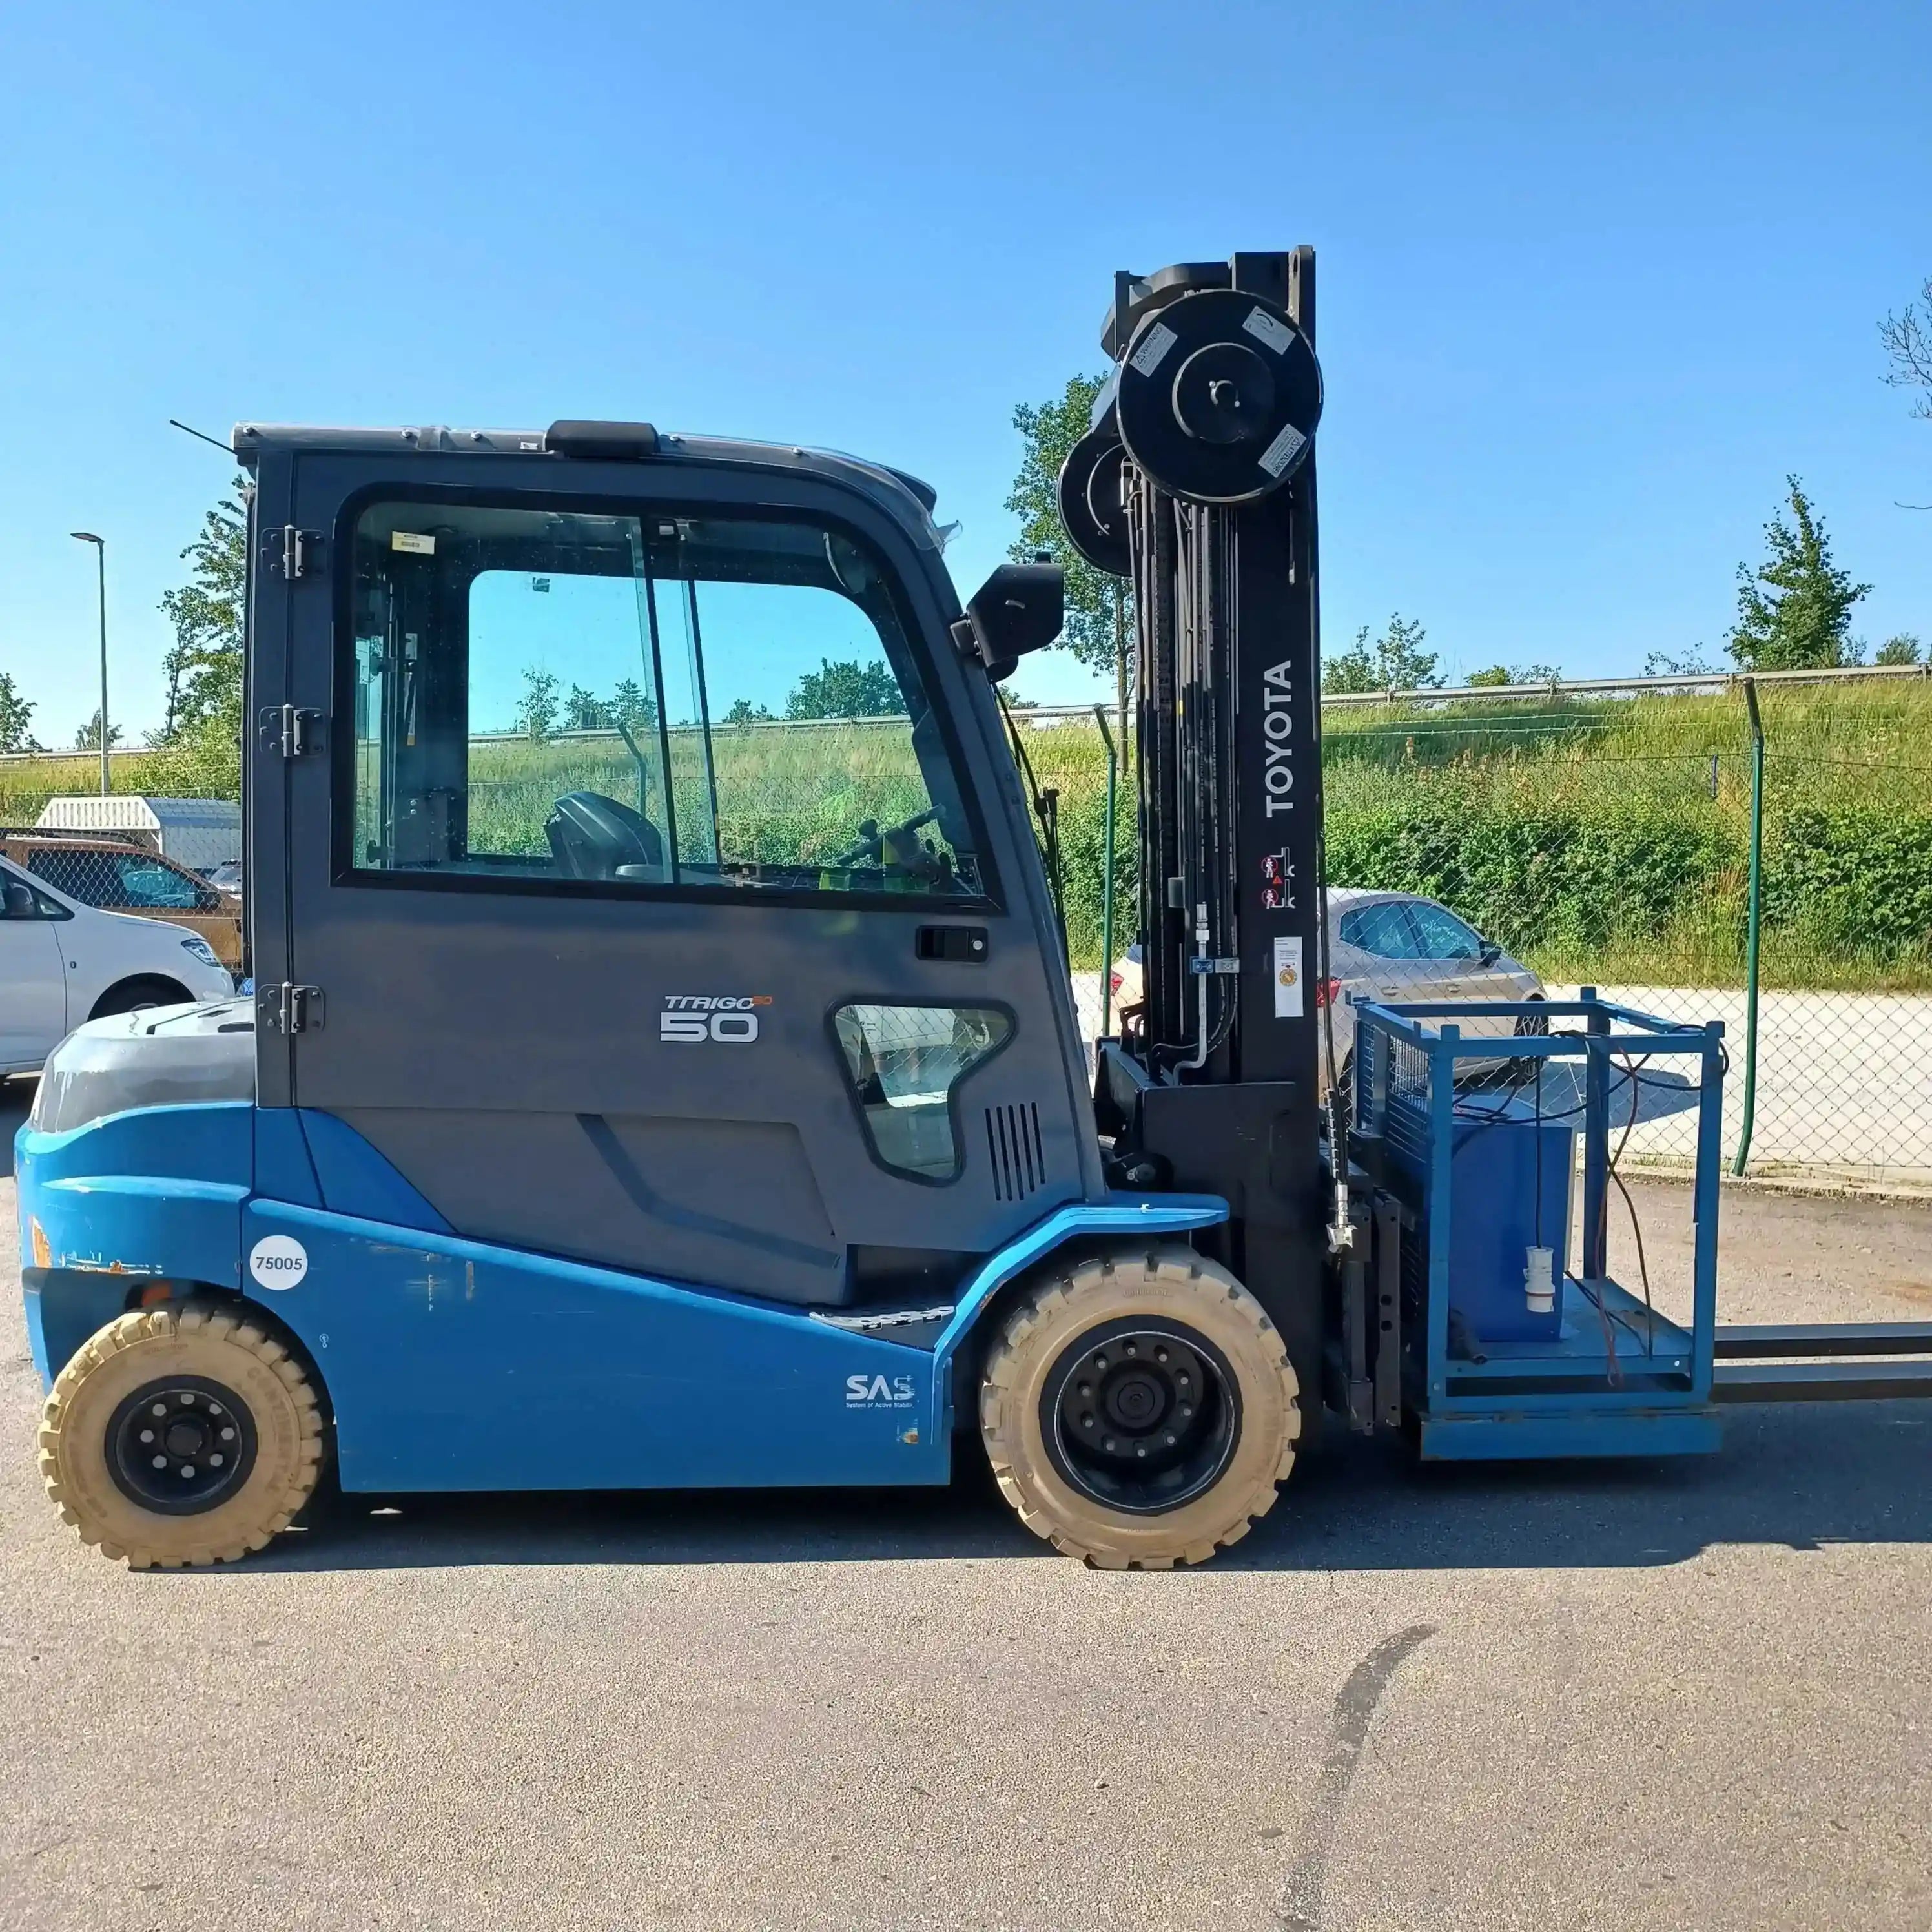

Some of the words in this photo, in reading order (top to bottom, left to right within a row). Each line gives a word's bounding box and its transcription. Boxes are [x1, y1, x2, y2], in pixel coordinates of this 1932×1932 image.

[1264, 660, 1293, 817] TOYOTA
[661, 1012, 758, 1042] 50
[256, 1257, 302, 1270] 75005
[846, 1375, 915, 1400] SAS
